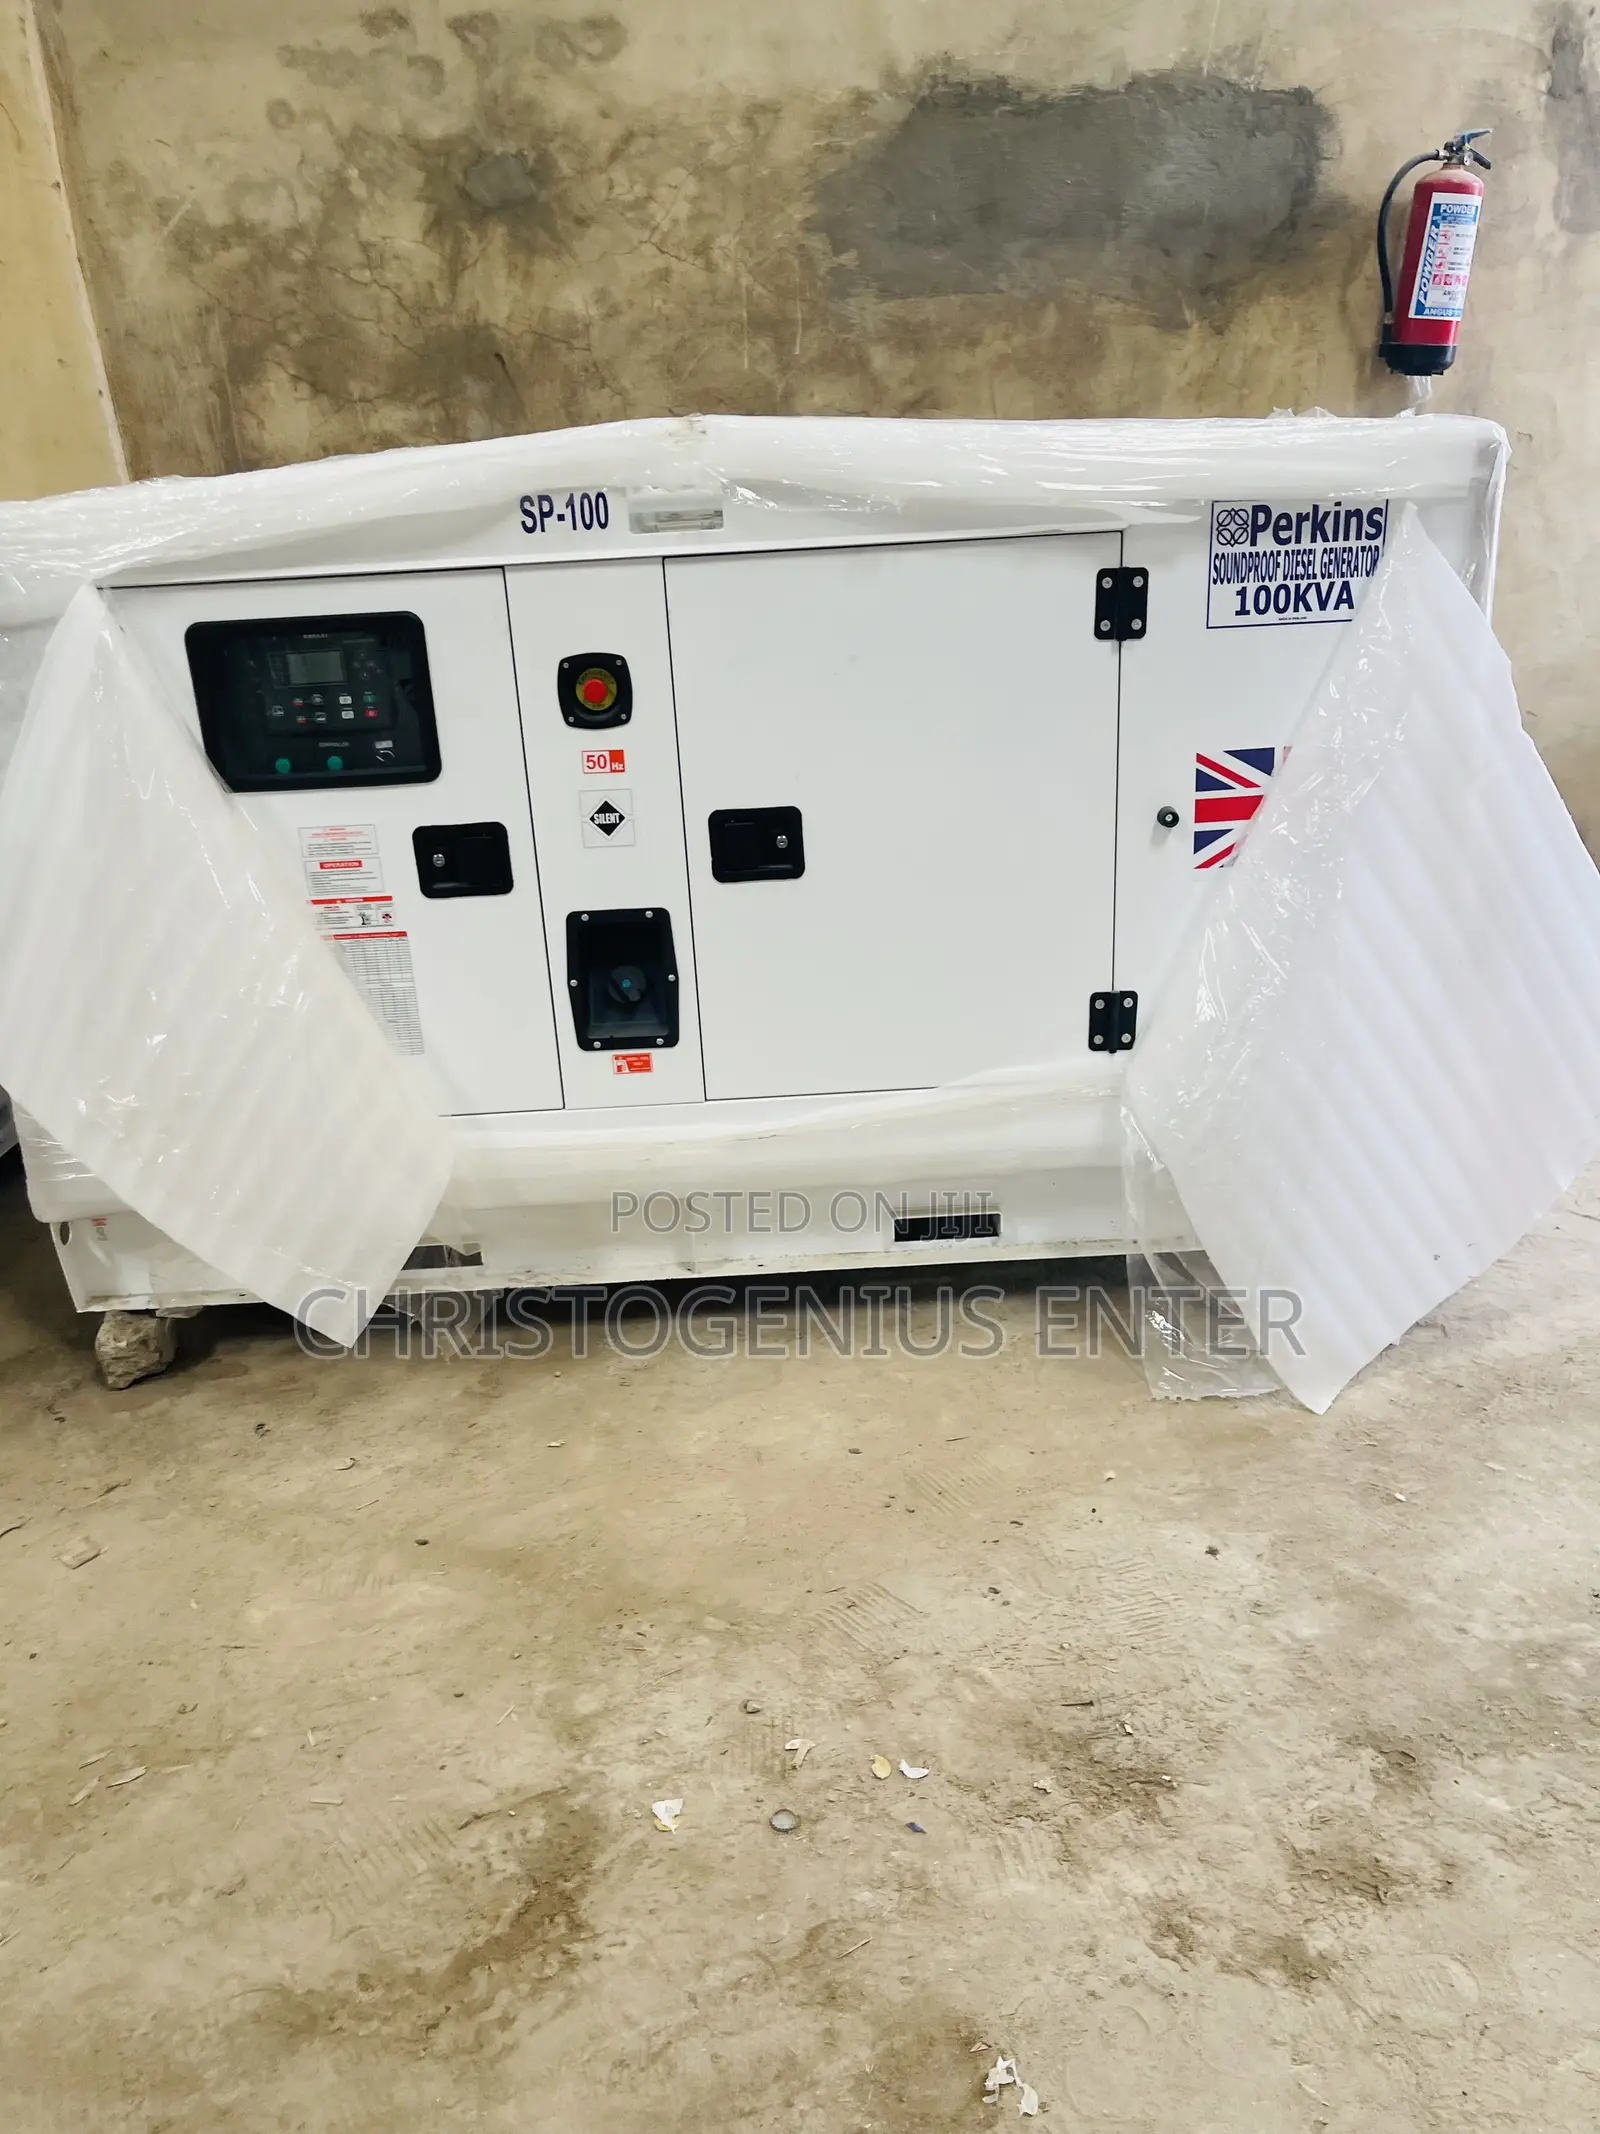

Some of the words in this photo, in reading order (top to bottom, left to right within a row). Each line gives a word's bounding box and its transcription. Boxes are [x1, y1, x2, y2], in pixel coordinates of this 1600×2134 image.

[1419, 225, 1439, 306] POWDER
[520, 491, 609, 534] SP-100
[1250, 501, 1384, 547] Perkins
[1212, 550, 1281, 585] SOUNDPROOF
[1283, 548, 1318, 582] DIESEL
[1235, 580, 1355, 617] 100KVA
[586, 754, 607, 769] 50
[593, 812, 620, 825] SILENT
